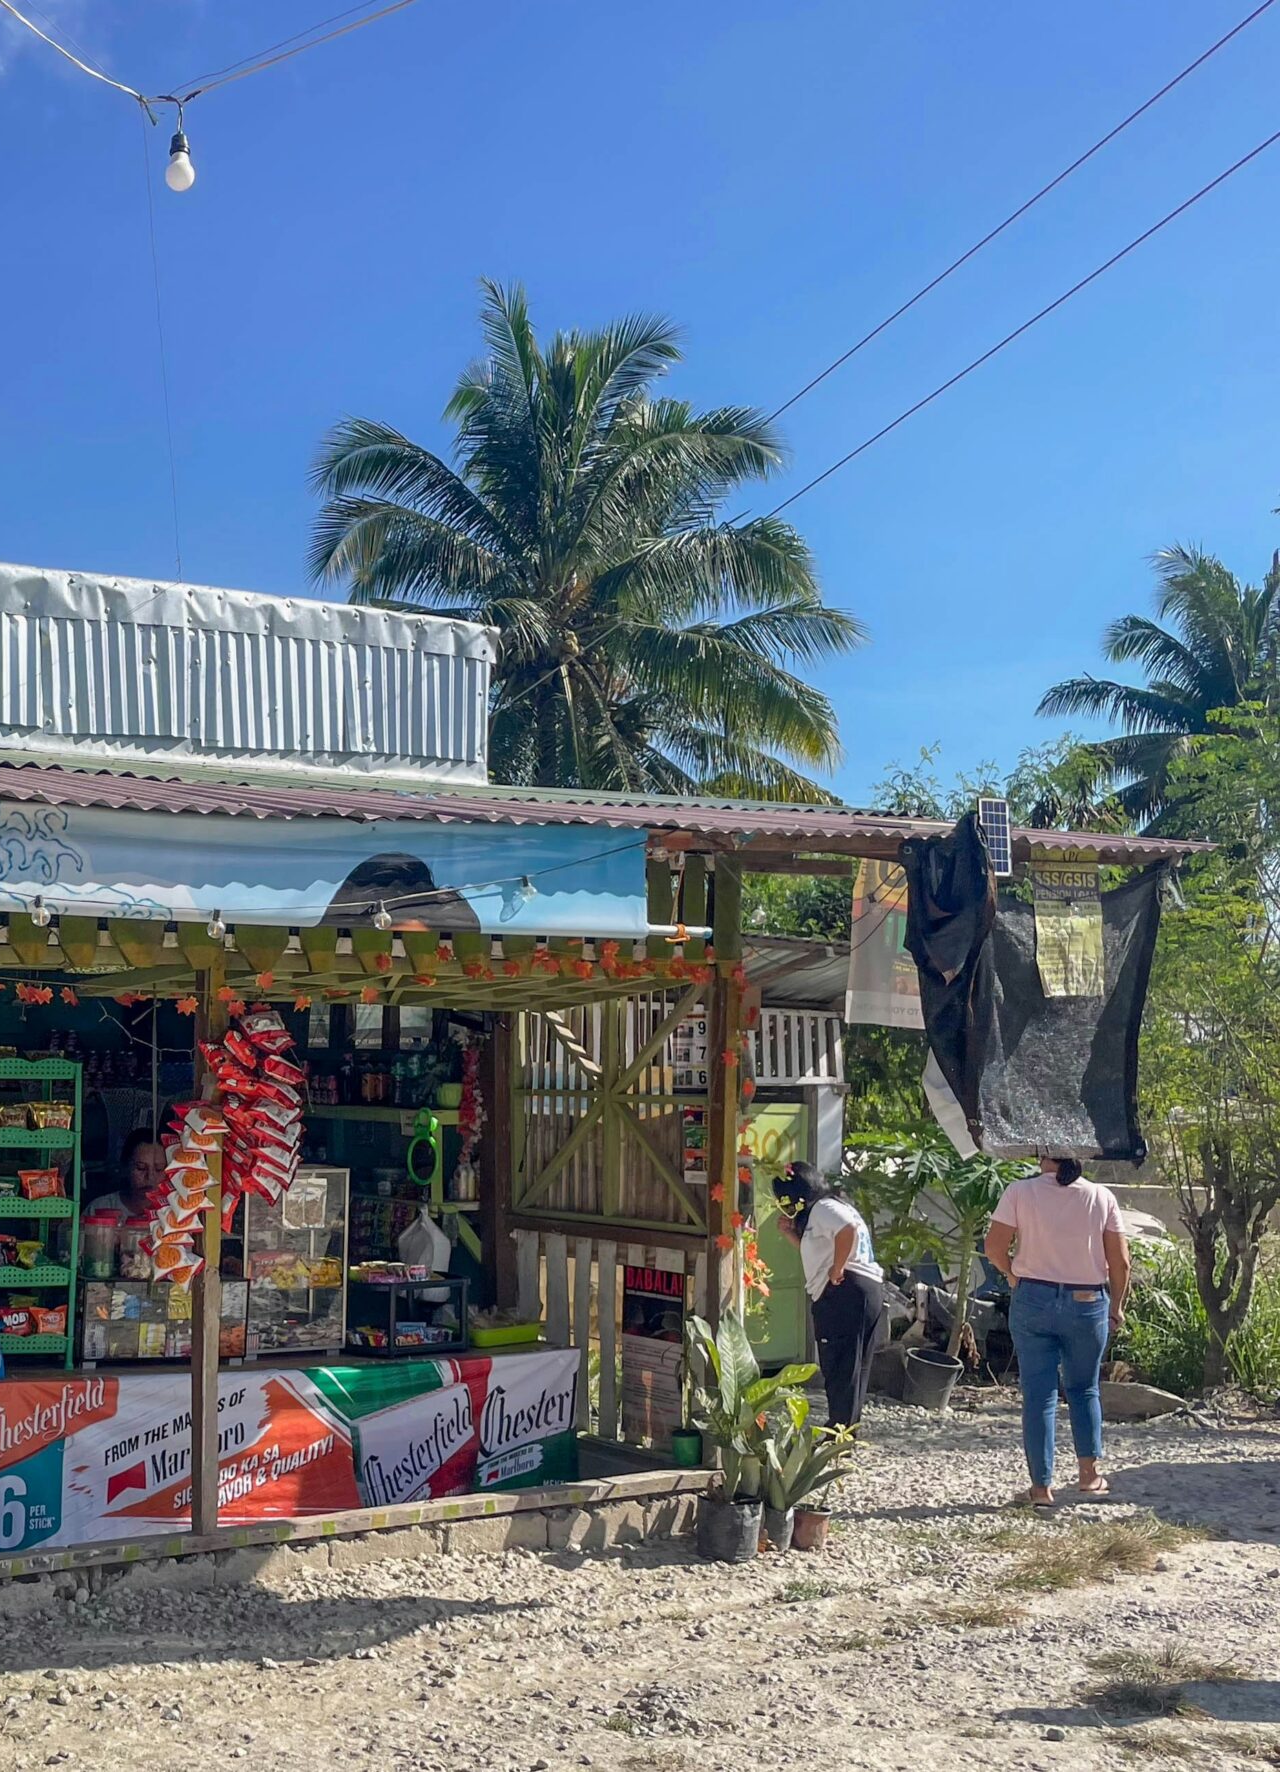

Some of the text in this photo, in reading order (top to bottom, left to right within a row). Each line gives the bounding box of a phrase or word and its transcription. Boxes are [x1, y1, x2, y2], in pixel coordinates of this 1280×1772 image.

[1034, 871, 1096, 888] SSS/GSIS
[626, 1266, 683, 1296] BABALA!
[104, 1435, 140, 1466] FROM
[144, 1422, 169, 1445] THE
[229, 1388, 247, 1407] OF
[241, 1454, 259, 1473] KA
[263, 1444, 280, 1464] SA
[364, 1388, 473, 1507] Chesterfield
[217, 1433, 335, 1508] AVOR & QUALITY!
[501, 1458, 535, 1477] Marlboro
[29, 1504, 46, 1517] PER
